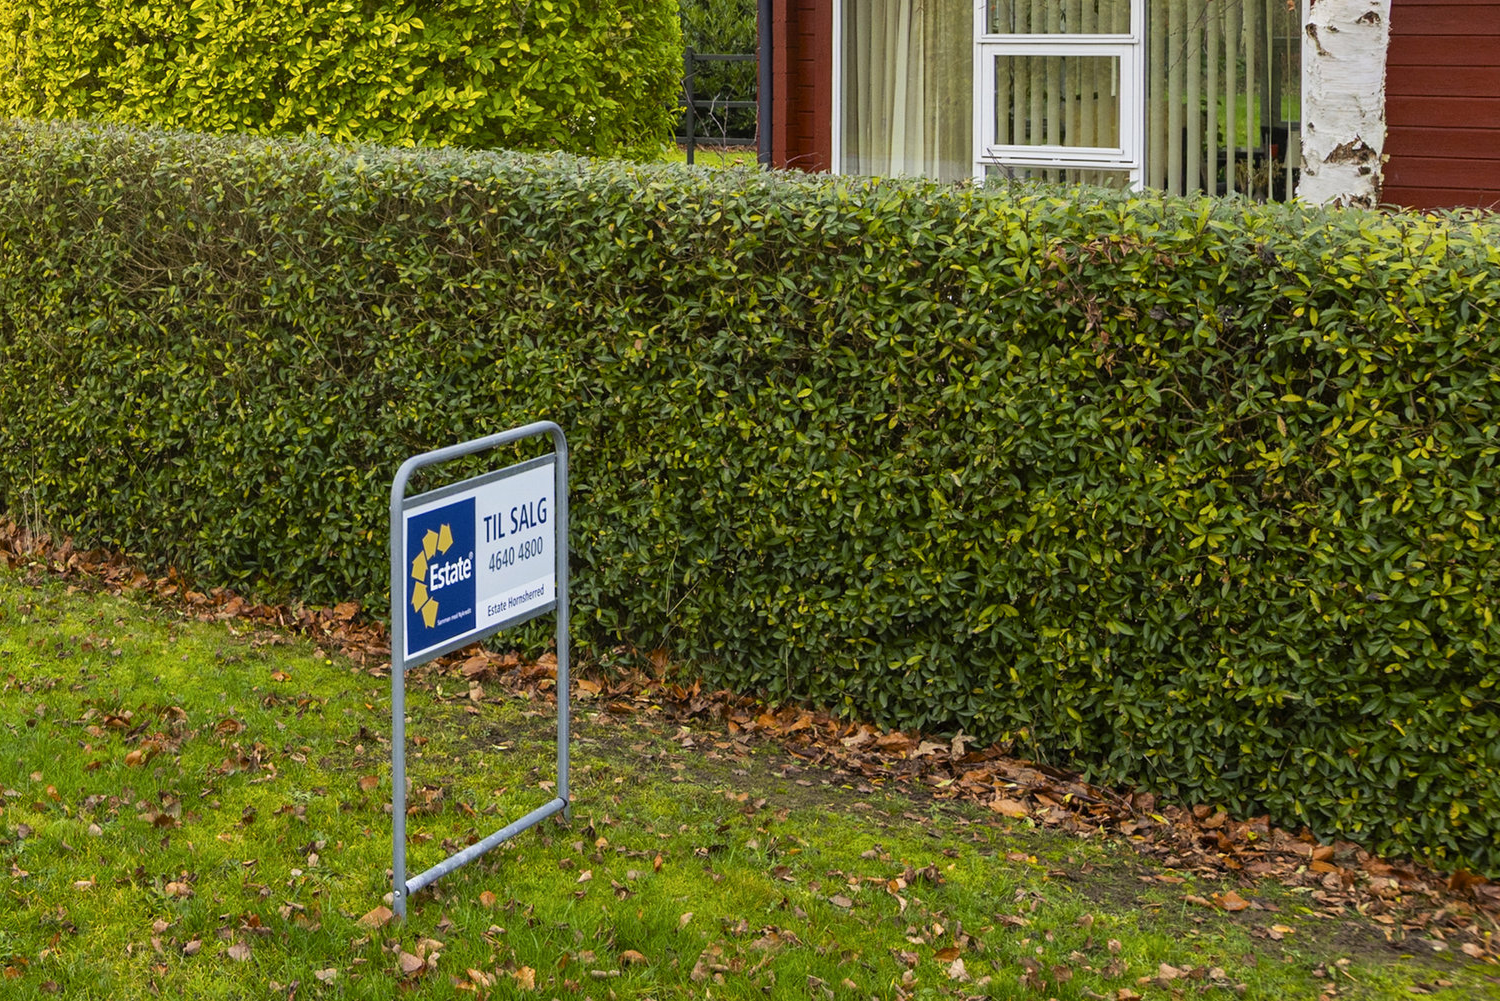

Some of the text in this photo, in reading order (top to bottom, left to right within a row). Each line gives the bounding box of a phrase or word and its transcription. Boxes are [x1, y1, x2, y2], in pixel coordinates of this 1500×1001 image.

[483, 497, 547, 543] TIL SALG
[489, 536, 543, 572] 4640 4800
[487, 584, 544, 617] Estate Hornsherred
